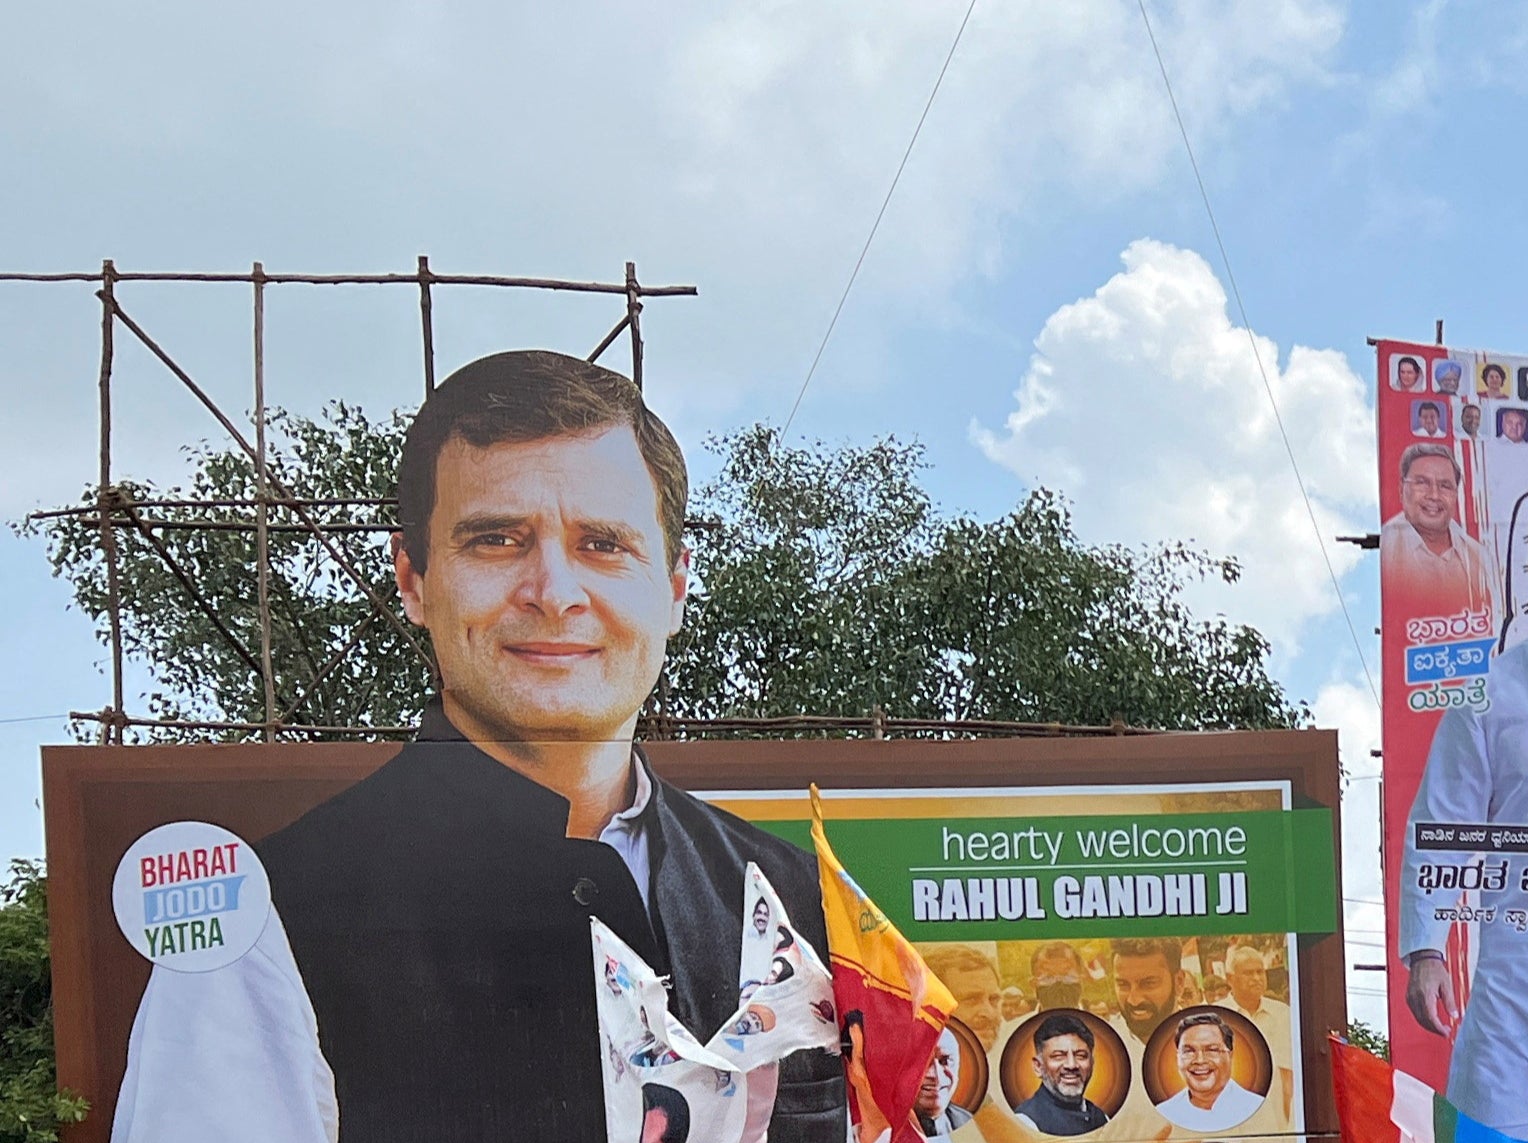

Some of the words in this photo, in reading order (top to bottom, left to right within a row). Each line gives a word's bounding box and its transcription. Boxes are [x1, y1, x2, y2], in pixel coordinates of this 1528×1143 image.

[1408, 608, 1491, 643] ಭಾರತ
[141, 842, 240, 888] BHARAT
[942, 826, 1063, 867] hearty
[1077, 823, 1247, 857] welcome
[913, 877, 1045, 921] RAHUL
[1054, 874, 1208, 918] GANDHI
[1216, 873, 1248, 915] JI
[1418, 860, 1508, 895] ಭಾರತ
[152, 883, 226, 921] JODO
[144, 917, 224, 957] YATRA
